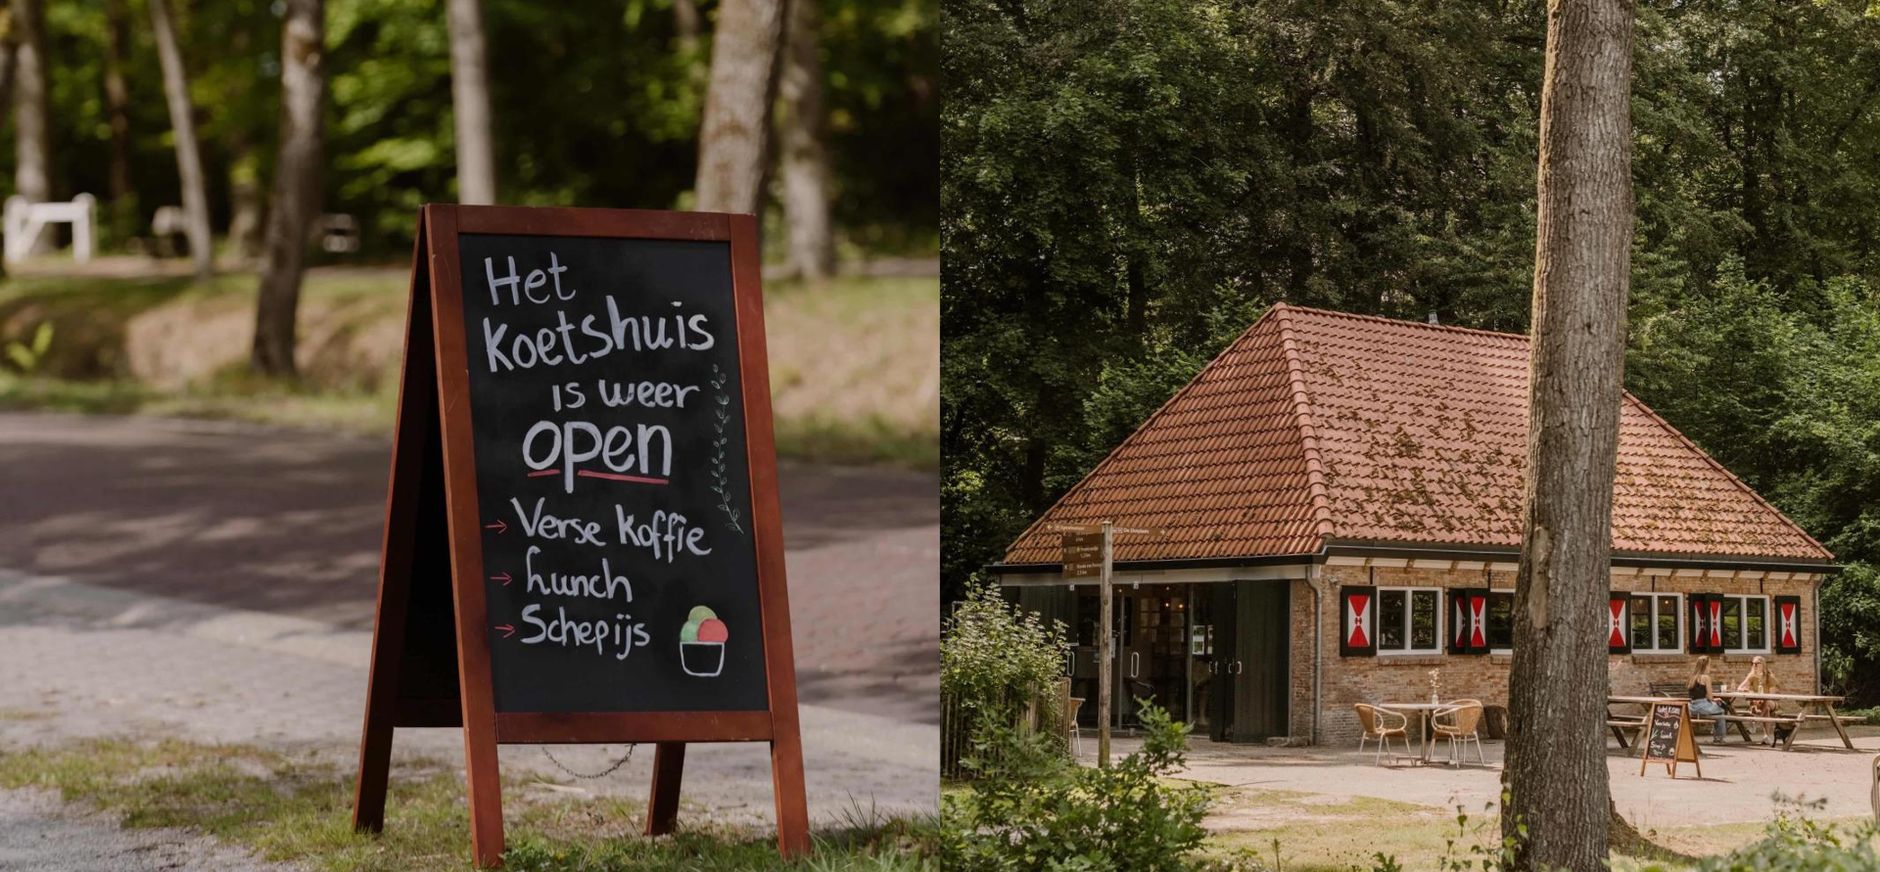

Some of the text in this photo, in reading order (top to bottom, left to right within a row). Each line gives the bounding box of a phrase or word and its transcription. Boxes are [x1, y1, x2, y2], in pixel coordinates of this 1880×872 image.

[484, 251, 576, 306] Het
[483, 295, 715, 373] Koetshuis
[552, 379, 700, 412] is weer
[522, 420, 673, 494] open
[510, 497, 607, 546] Verse
